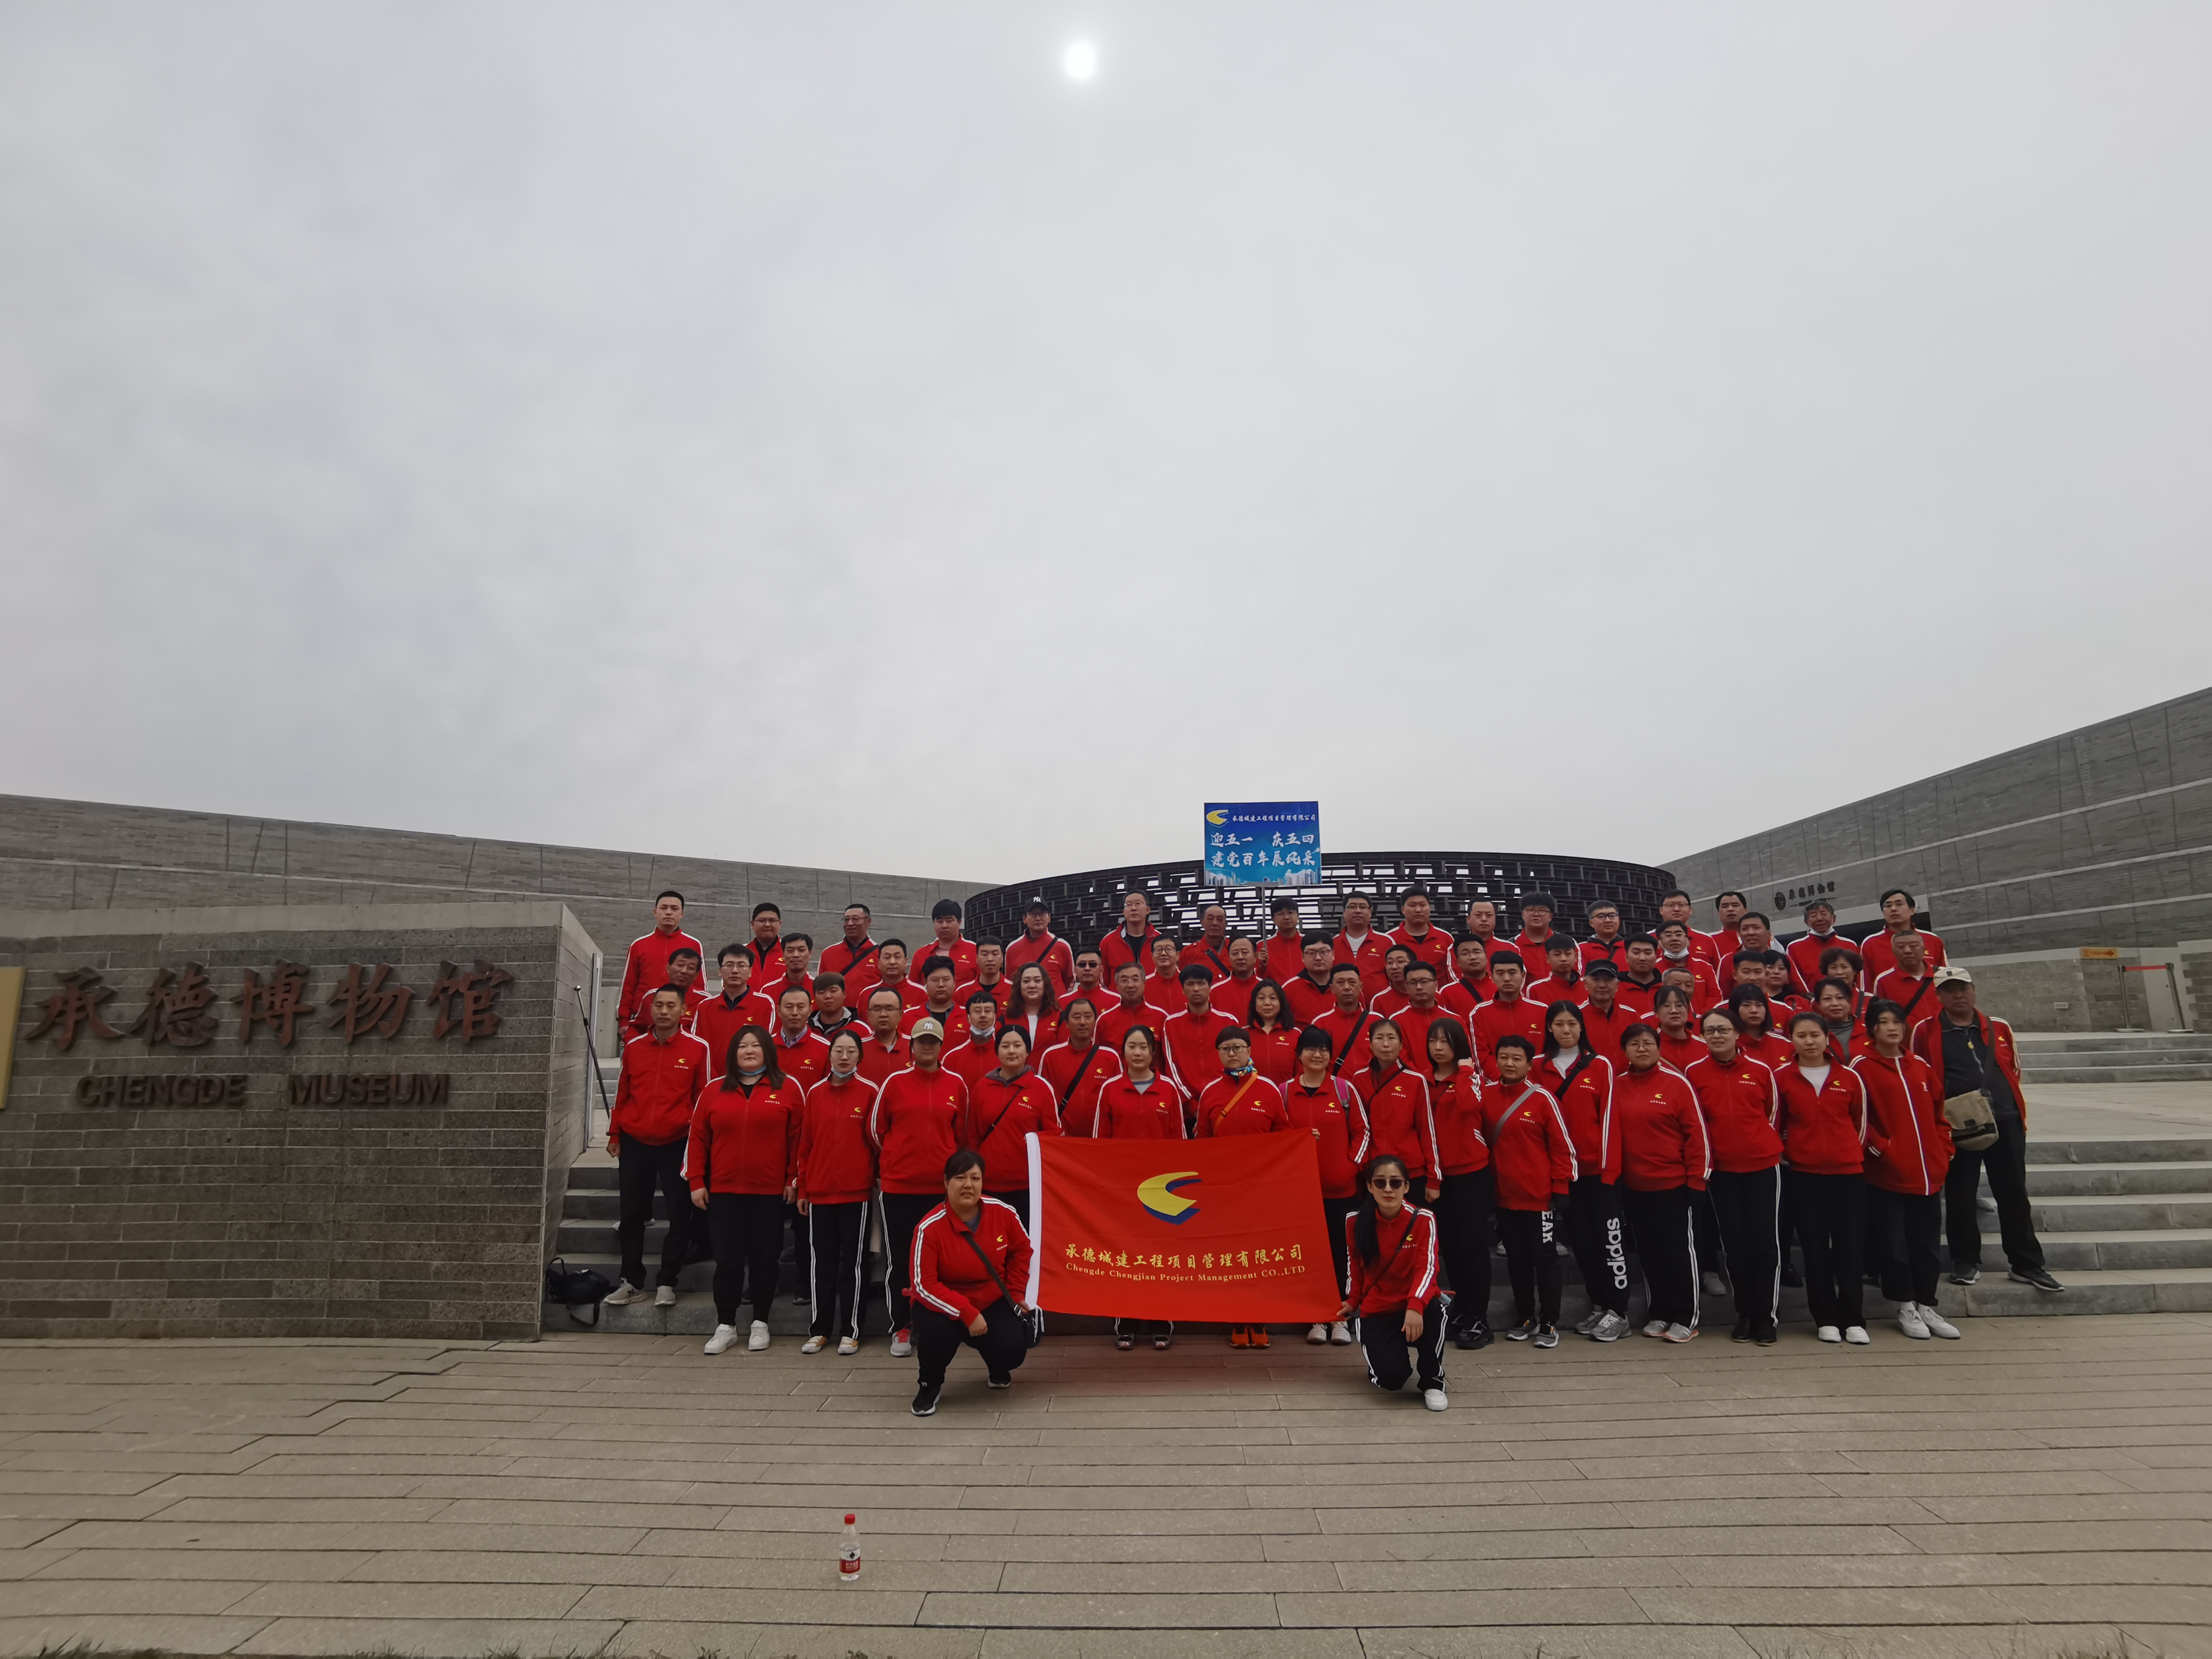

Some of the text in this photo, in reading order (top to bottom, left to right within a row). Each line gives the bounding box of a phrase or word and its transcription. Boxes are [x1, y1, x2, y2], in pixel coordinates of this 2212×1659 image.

[1210, 831, 1315, 848] 迎五一 庆五四
[1211, 850, 1316, 868] 建党百年展风采
[25, 959, 514, 1051] 承德博物馆
[76, 1073, 450, 1107] CHENGDE MUSEUM
[1065, 1243, 1302, 1270] 承德城建工程项目管理有限公司
[1606, 1217, 1628, 1289] adidas
[1066, 1262, 1306, 1283] Chengde Chengjian Project Management CO.,LTD
